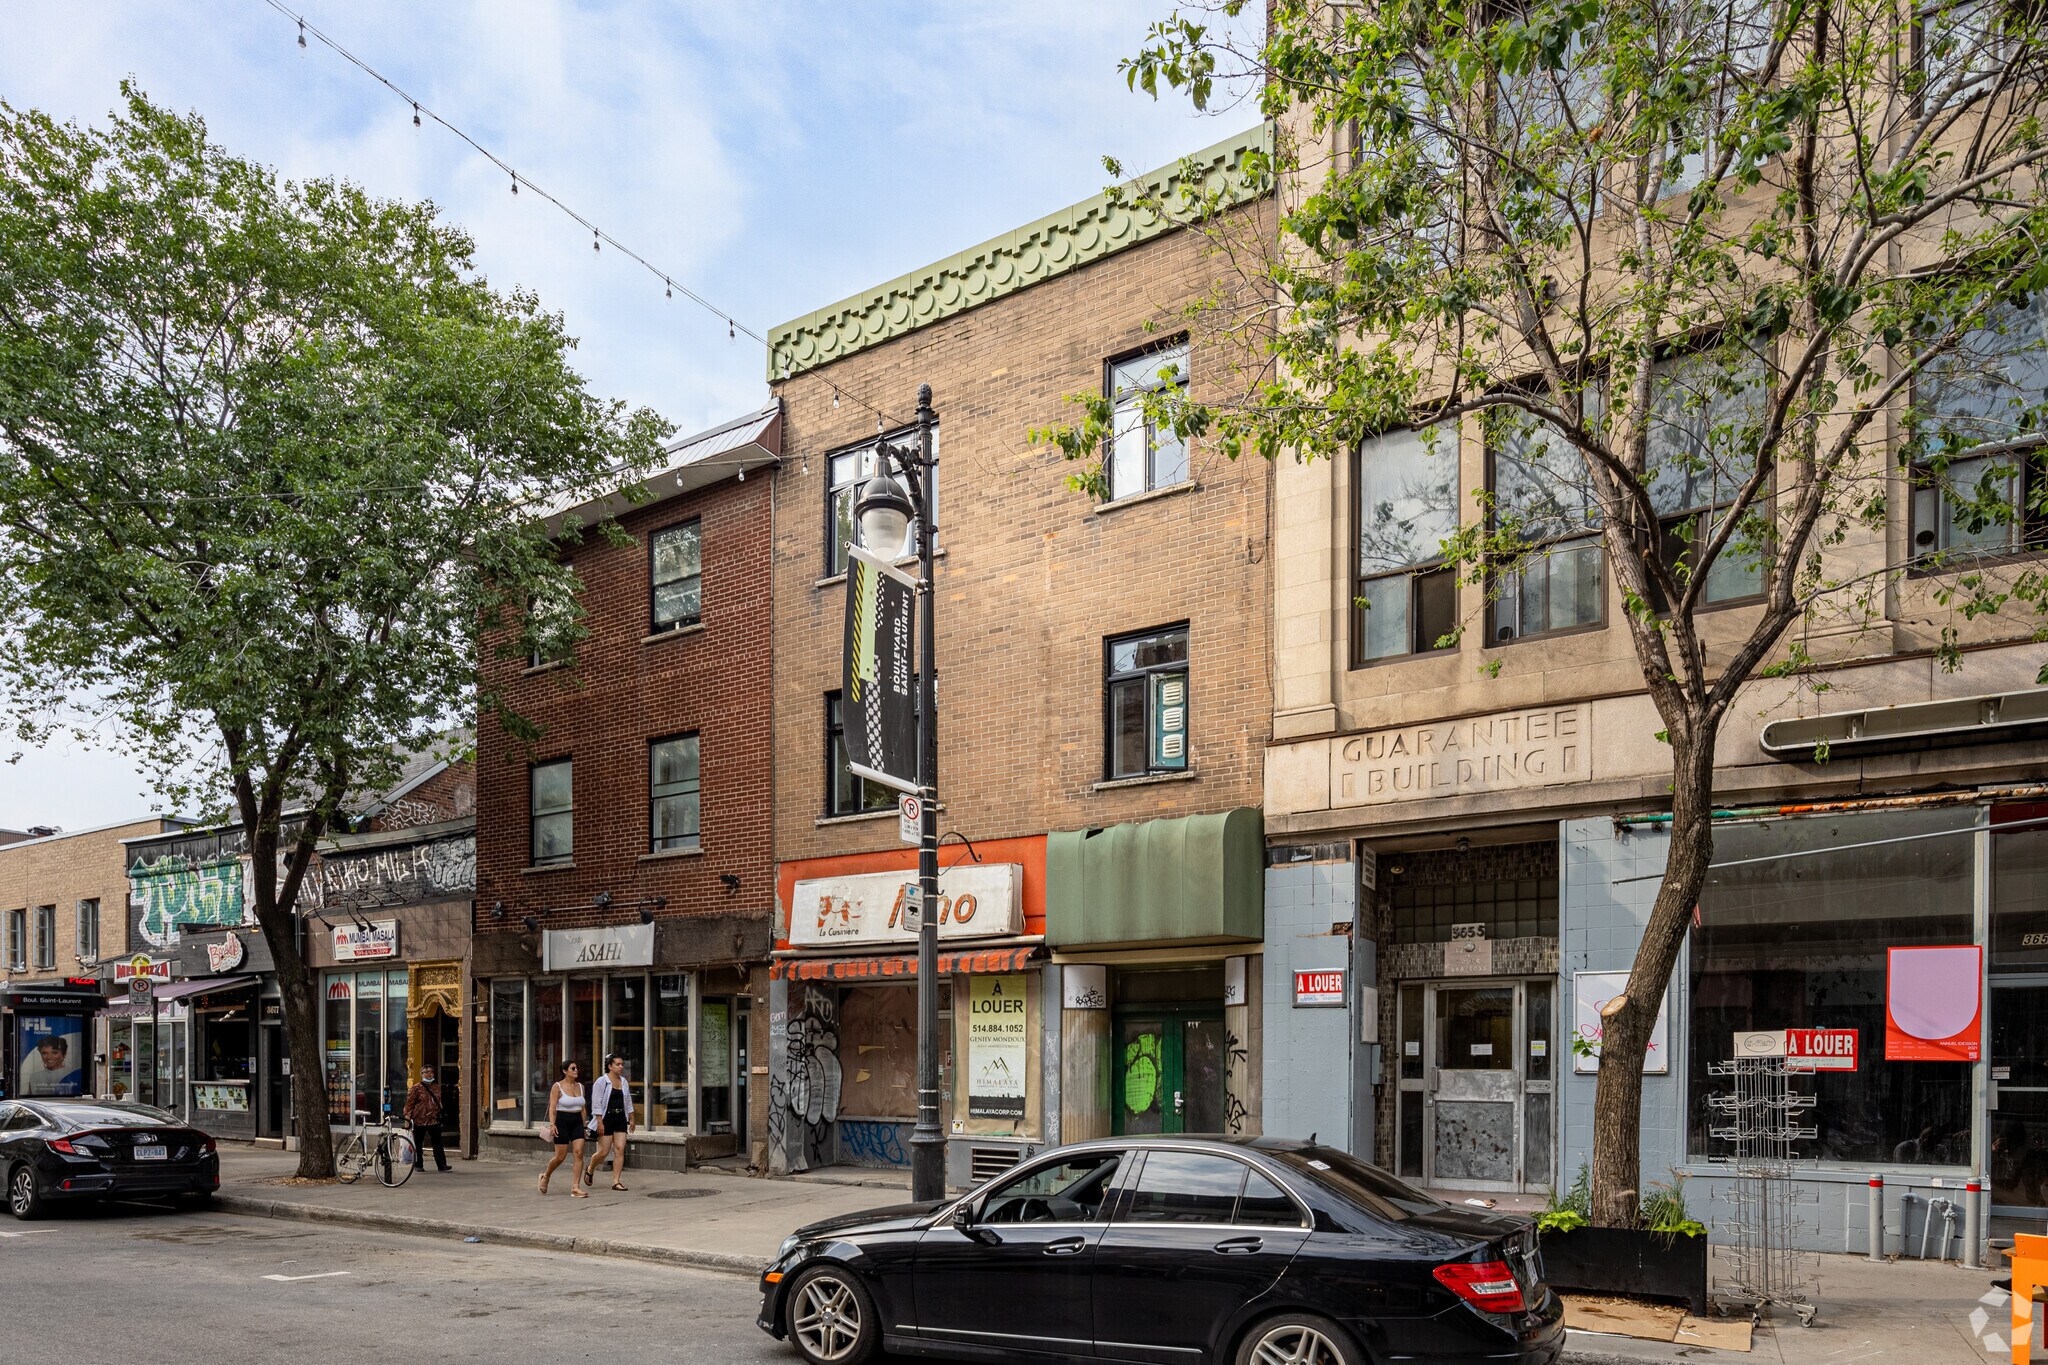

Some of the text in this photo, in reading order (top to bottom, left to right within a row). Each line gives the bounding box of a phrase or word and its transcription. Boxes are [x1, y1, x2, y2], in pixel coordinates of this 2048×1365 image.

[901, 590, 909, 696] SAINT-LAURENT
[893, 617, 902, 693] BOULEVARD
[1342, 708, 1577, 763] GUARANTEE
[1367, 748, 1546, 796] BUILDING
[372, 929, 395, 942] MASALA
[1452, 924, 1486, 940] 3655
[576, 942, 624, 963] ASAHI
[140, 962, 169, 977] PIZZA
[69, 977, 96, 985] PIZZA
[992, 979, 1003, 996] À
[1308, 974, 1342, 992] LOUER
[39, 996, 82, 1005] Saint-Laurent
[972, 999, 1024, 1014] LOUER
[972, 1024, 1024, 1033] 514.884.1052
[1805, 1034, 1854, 1055] LOUER
[970, 1107, 1024, 1116] HIMALAYACORP.COM
